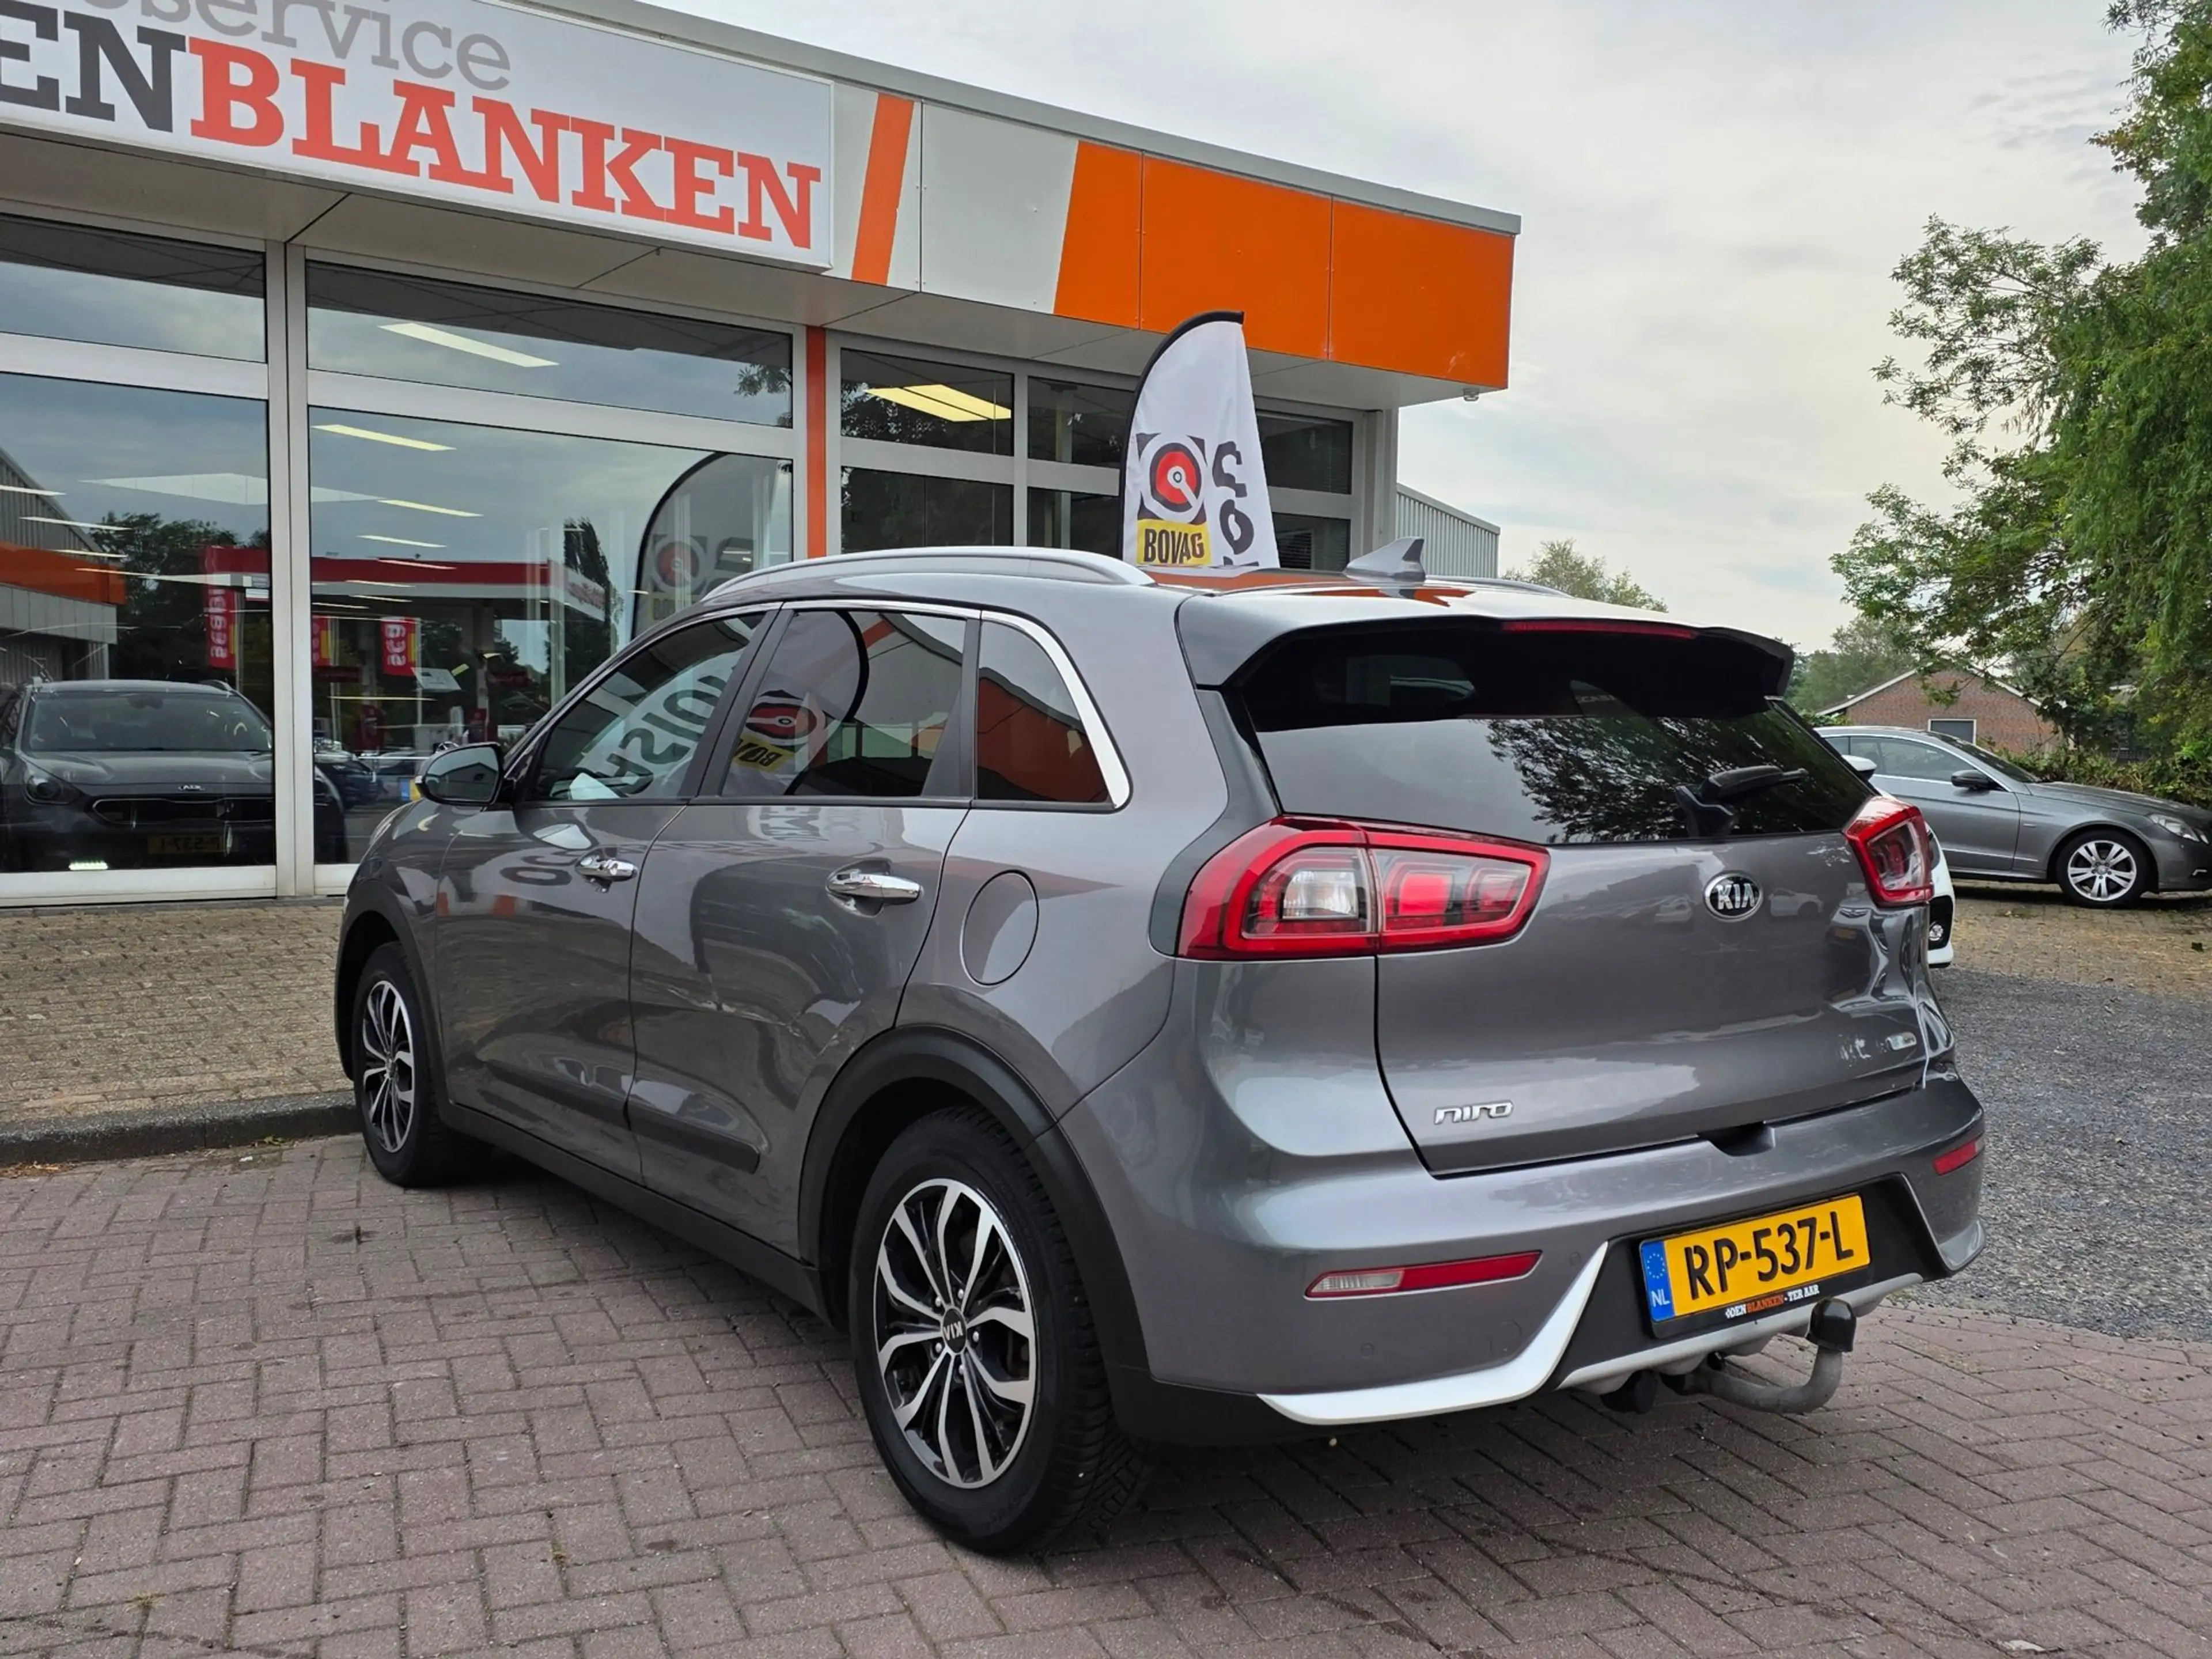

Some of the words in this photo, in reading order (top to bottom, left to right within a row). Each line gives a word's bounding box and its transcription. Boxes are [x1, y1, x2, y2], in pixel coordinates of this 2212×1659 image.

[82, 0, 511, 90] ervice
[1143, 528, 1205, 564] BOVAG
[1716, 882, 1755, 910] KIA
[1684, 1211, 1854, 1300] RP-537-L
[1651, 1288, 1671, 1308] NL
[943, 1321, 963, 1341] KIA
